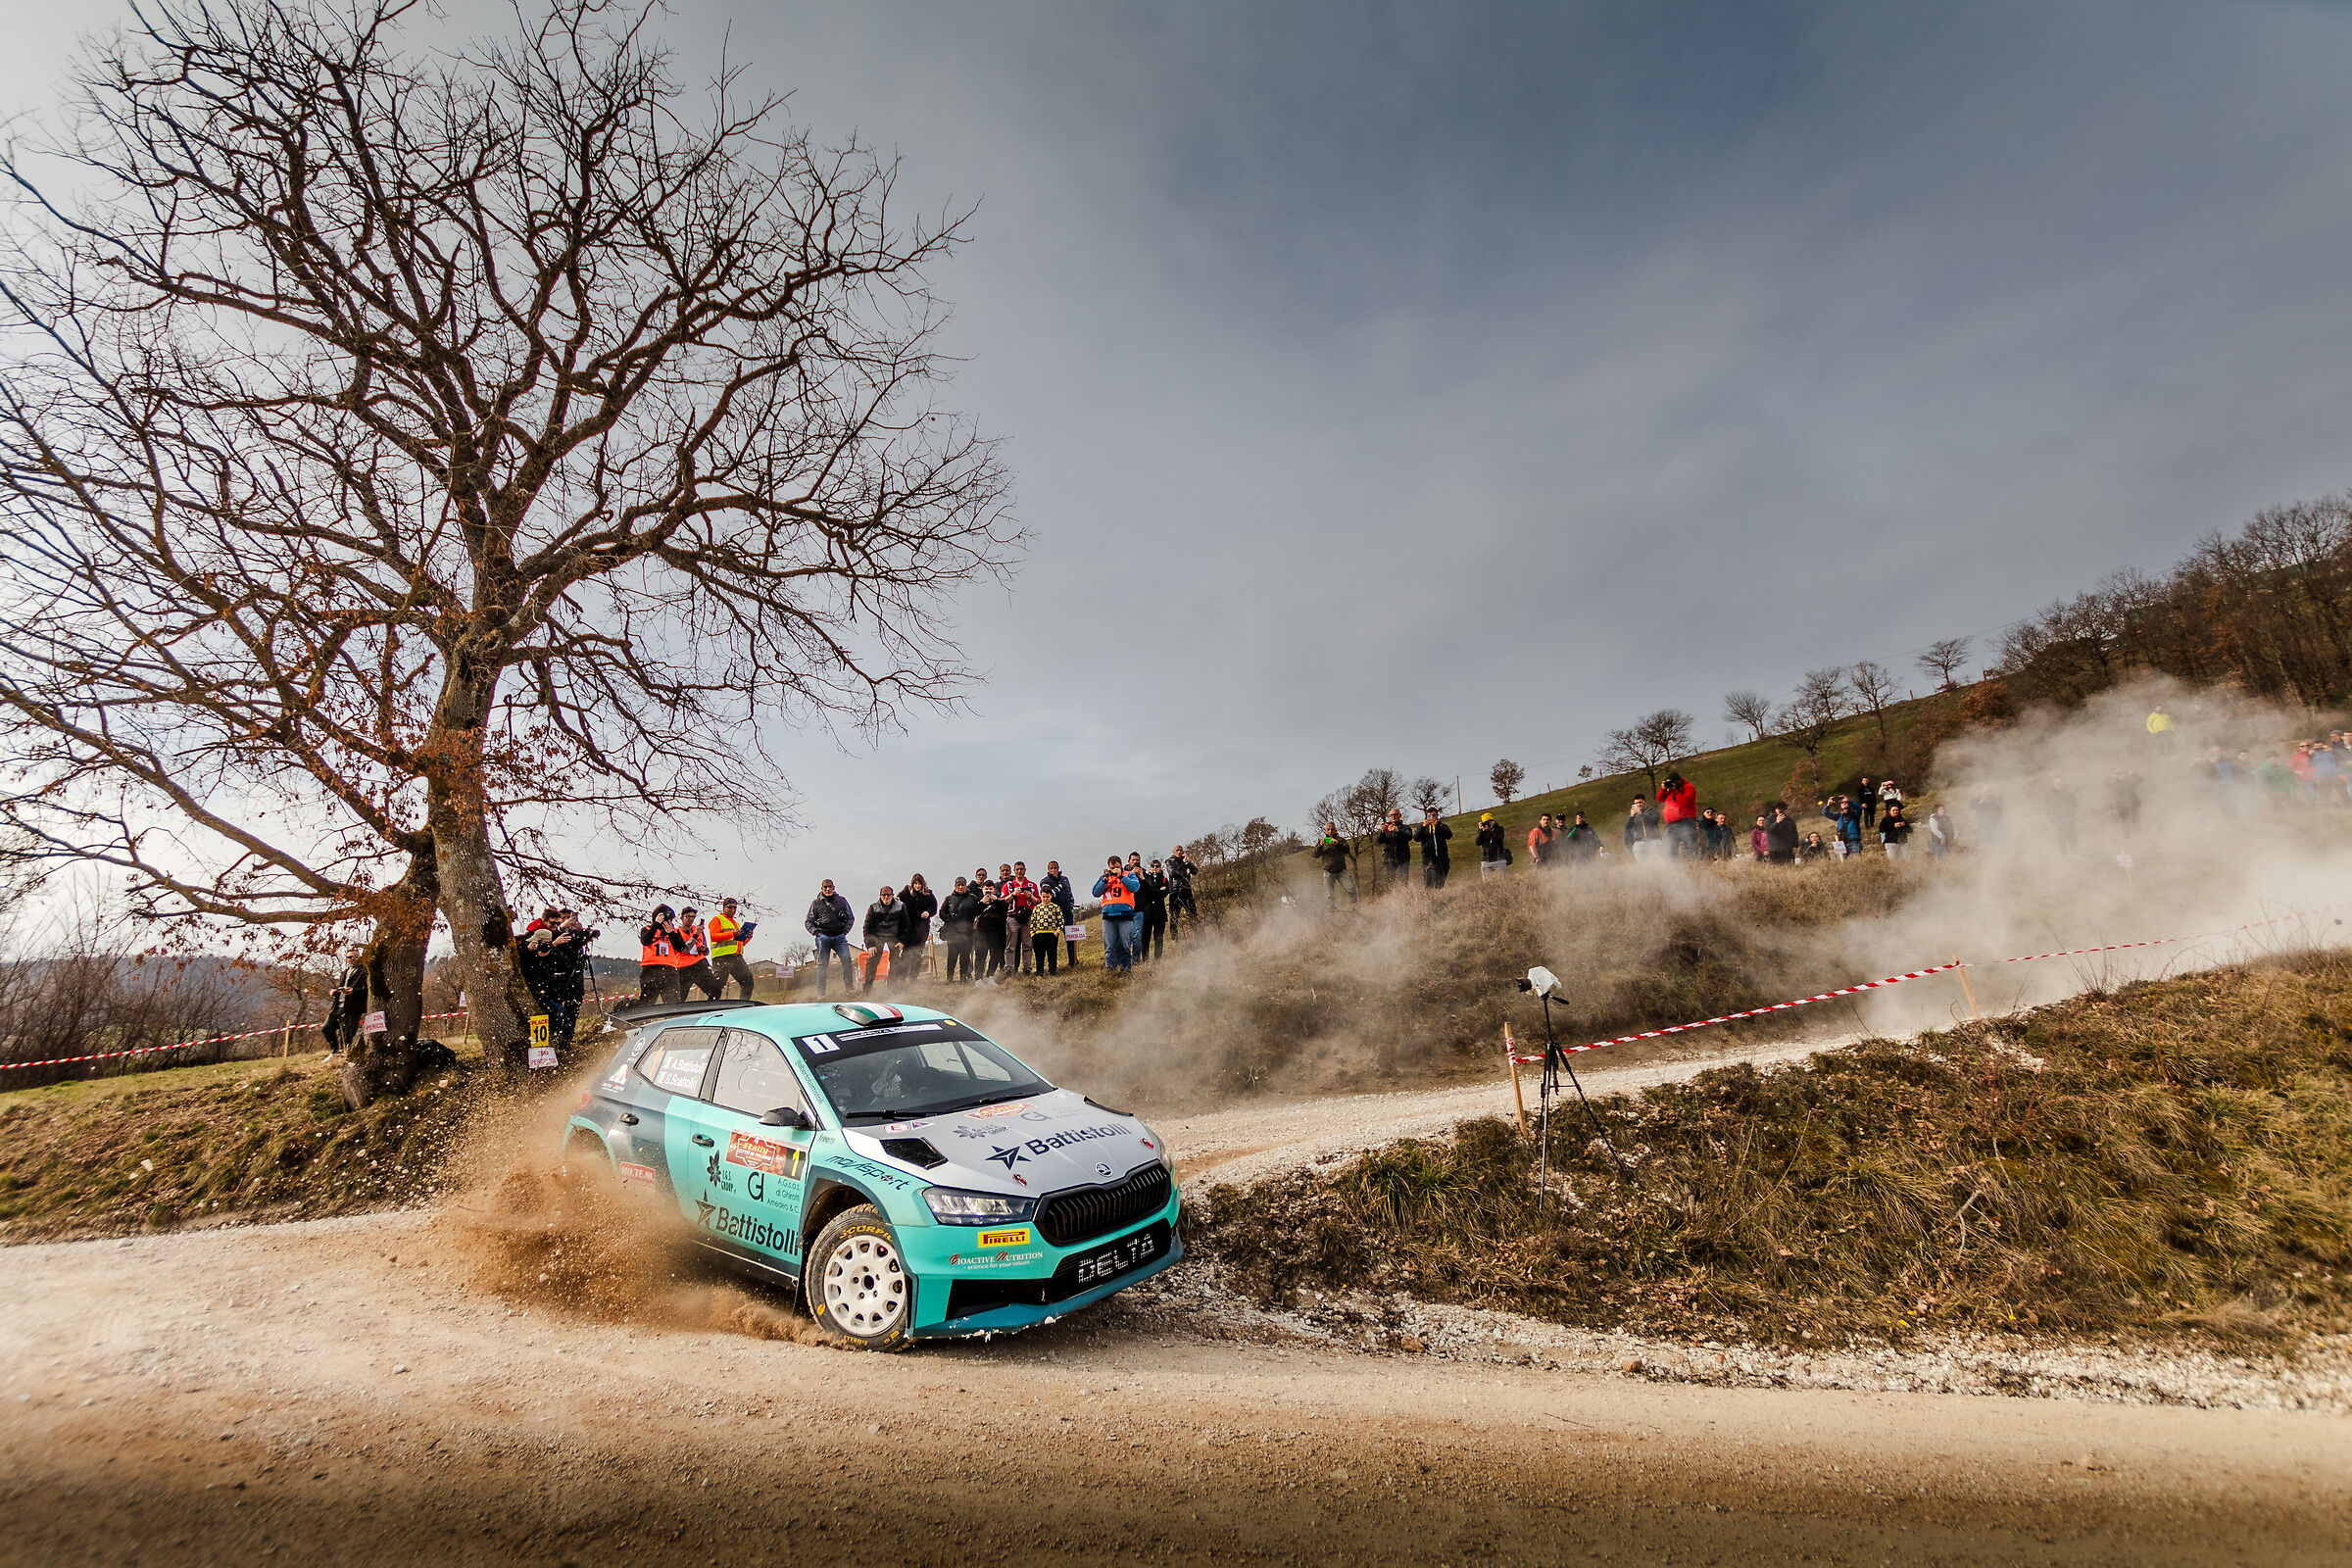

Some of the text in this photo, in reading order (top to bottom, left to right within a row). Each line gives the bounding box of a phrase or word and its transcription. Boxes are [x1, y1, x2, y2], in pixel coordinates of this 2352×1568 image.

[534, 1025, 547, 1043] 10
[812, 1037, 829, 1051] 1
[1025, 1123, 1132, 1155] Battistolli
[792, 1148, 801, 1177] 1
[715, 1206, 799, 1256] Battistolli
[983, 1231, 1025, 1245] PIRELLI
